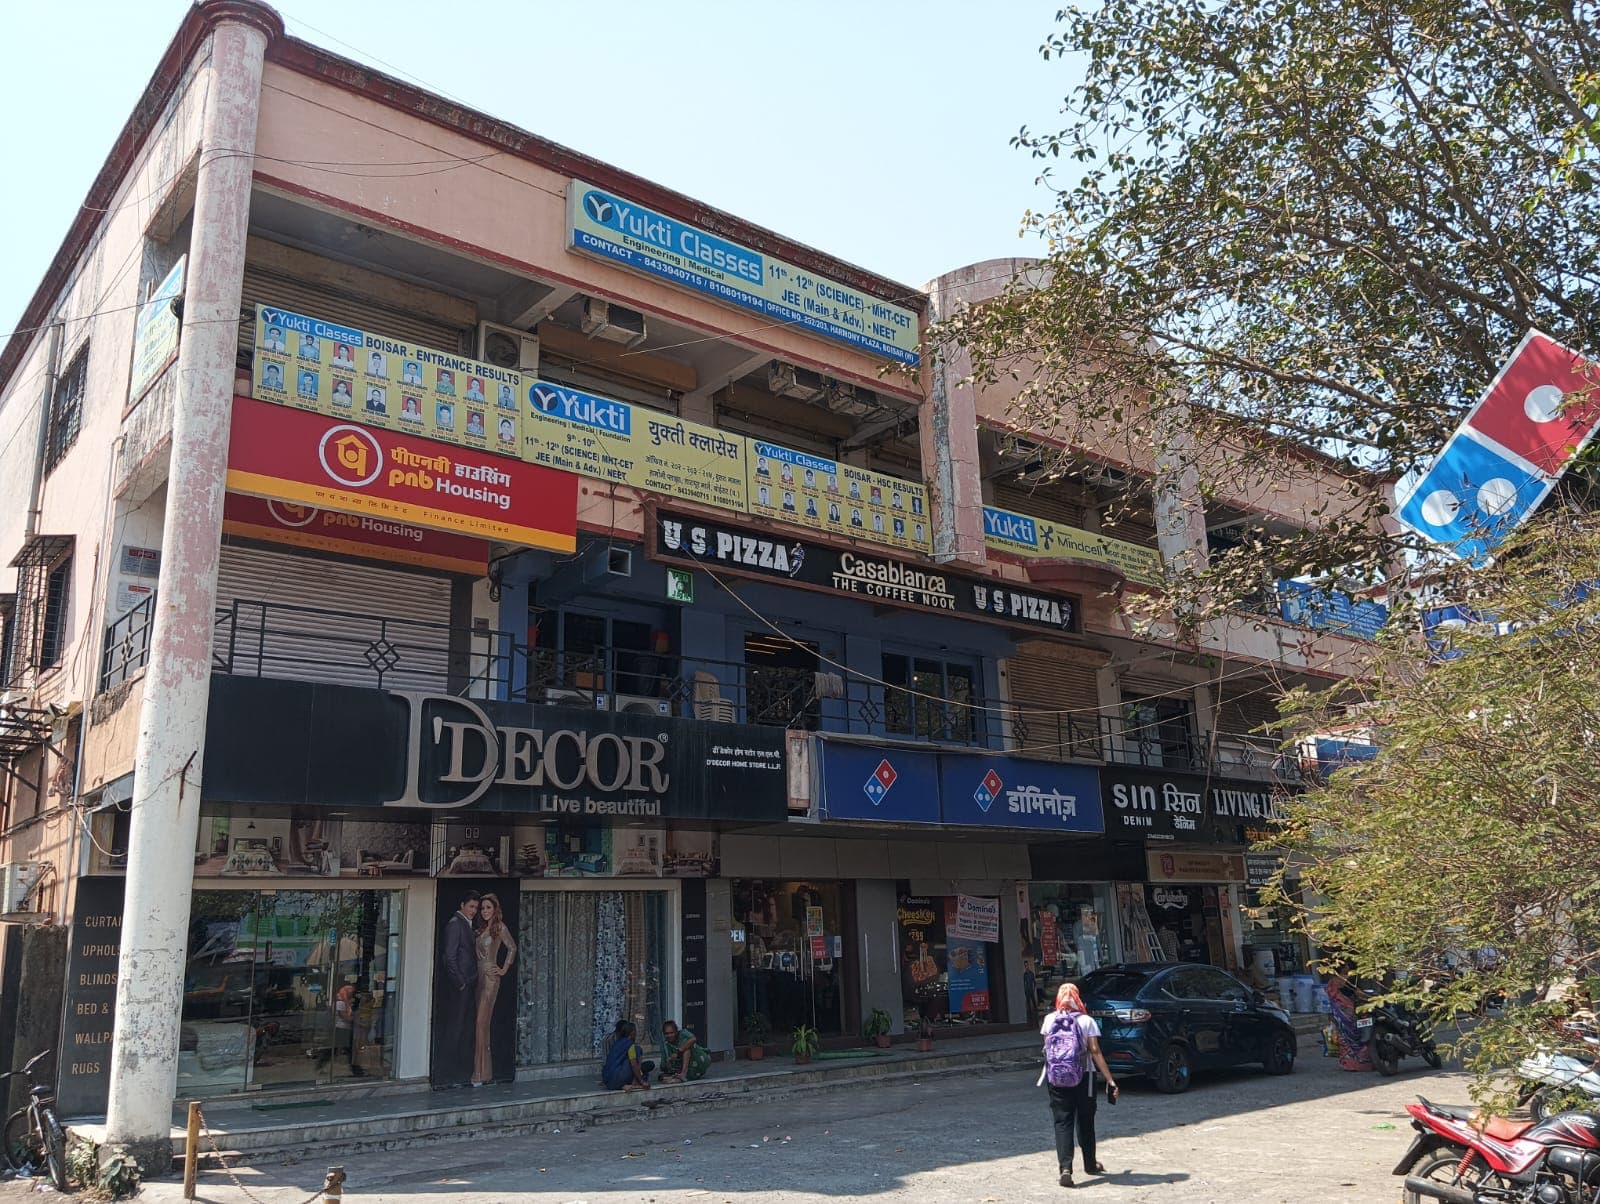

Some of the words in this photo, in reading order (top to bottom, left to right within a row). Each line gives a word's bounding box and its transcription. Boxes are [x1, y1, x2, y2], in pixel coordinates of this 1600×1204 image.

[614, 203, 671, 247] Yukti
[680, 231, 760, 281] Classes
[623, 236, 681, 266] Engineering
[689, 260, 725, 280] Medical
[582, 234, 633, 259] CONTACT
[644, 257, 702, 285] 8433940715
[709, 281, 763, 307] 8108019194
[769, 265, 787, 280] 11th
[796, 275, 814, 290] 12th
[816, 282, 864, 314] (SCIENCE)
[872, 303, 911, 329] MHT-CET
[277, 312, 310, 333] Yukti
[314, 323, 362, 345] Classes
[767, 302, 791, 318] OFFICE
[830, 325, 860, 342] HARMONY
[781, 290, 801, 307] JEE
[803, 296, 829, 317] (Main
[833, 308, 839, 320] &
[842, 314, 865, 332] Adv.)
[873, 322, 897, 341] NEET
[366, 336, 407, 357] BOISAR
[416, 349, 473, 373] ENTRANCE
[475, 364, 520, 386] RESULTS
[557, 390, 625, 430] Yukti
[530, 411, 567, 428] Engineering
[599, 429, 631, 443] Foundation
[648, 420, 685, 446] युक्ती
[688, 432, 738, 460] क्लासेस
[390, 446, 451, 474] पीएनबी
[454, 461, 512, 488] हाउसिंग
[535, 452, 551, 463] JEE
[764, 445, 792, 462] Yukti
[796, 452, 836, 474] Classes
[388, 468, 434, 491] pnb
[435, 481, 511, 509] Housing
[645, 479, 672, 490] CONTACT
[844, 468, 871, 483] BOISAR
[877, 477, 891, 489] HSC
[893, 481, 924, 497] RESULTS
[361, 518, 424, 542] Housing
[423, 511, 465, 525] Finance
[469, 519, 510, 533] Limited
[984, 510, 1033, 542] Yukti
[717, 532, 789, 571] PIZZA
[840, 552, 946, 593] Casablanca
[832, 576, 858, 593] THE
[866, 584, 915, 602] COFFEE
[922, 593, 956, 611] NOOK
[1009, 593, 1062, 624] PIZZA
[540, 794, 580, 814] Live
[584, 796, 662, 816] beautiful
[1162, 783, 1202, 814] सिन
[1213, 789, 1261, 818] LIVING
[1124, 816, 1152, 826] DENIM
[80, 973, 117, 985] BLINDS
[77, 1003, 97, 1015] BED
[101, 1003, 109, 1014] &
[72, 1062, 100, 1074] RUGS
